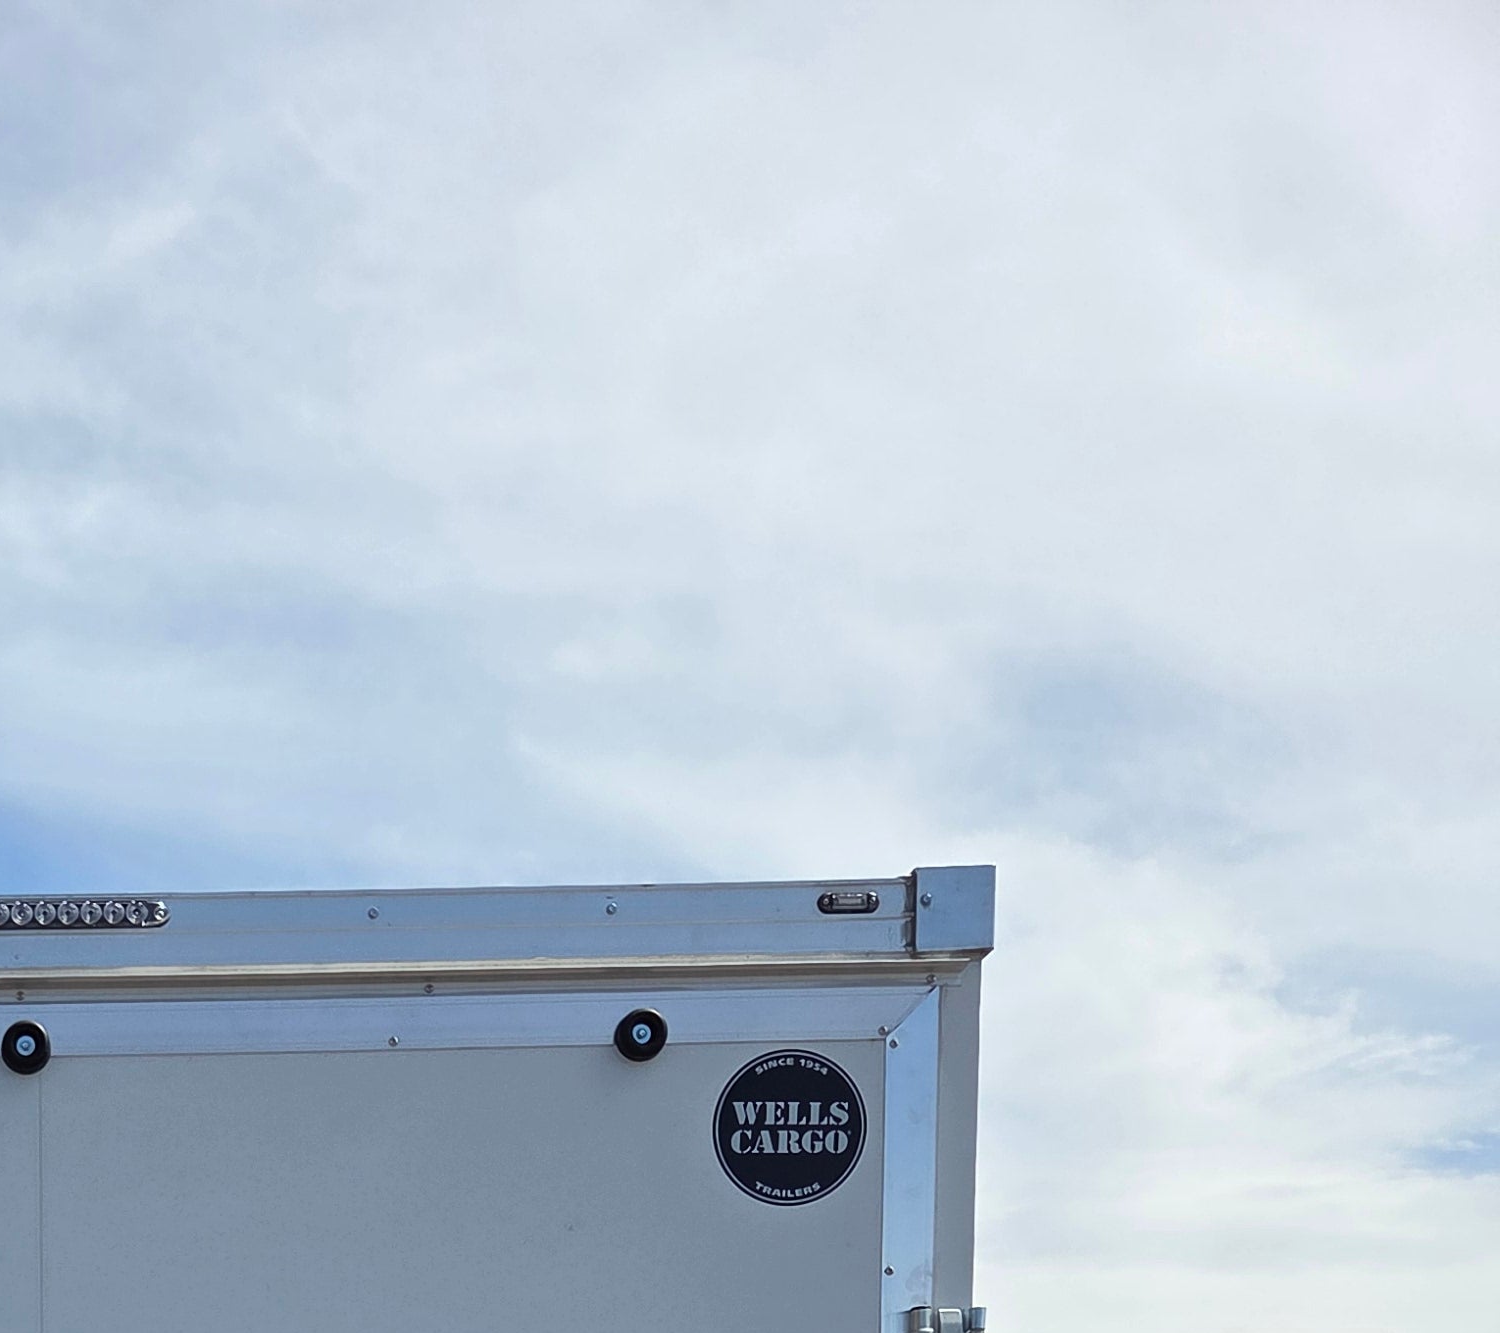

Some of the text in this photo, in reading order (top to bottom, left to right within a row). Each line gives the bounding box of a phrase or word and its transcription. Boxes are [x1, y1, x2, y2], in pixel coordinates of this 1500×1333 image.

[755, 1057, 829, 1075] SINCE 1954
[732, 1102, 849, 1125] WELLS
[730, 1130, 849, 1154] CARGO
[755, 1181, 821, 1198] TRAILERS
